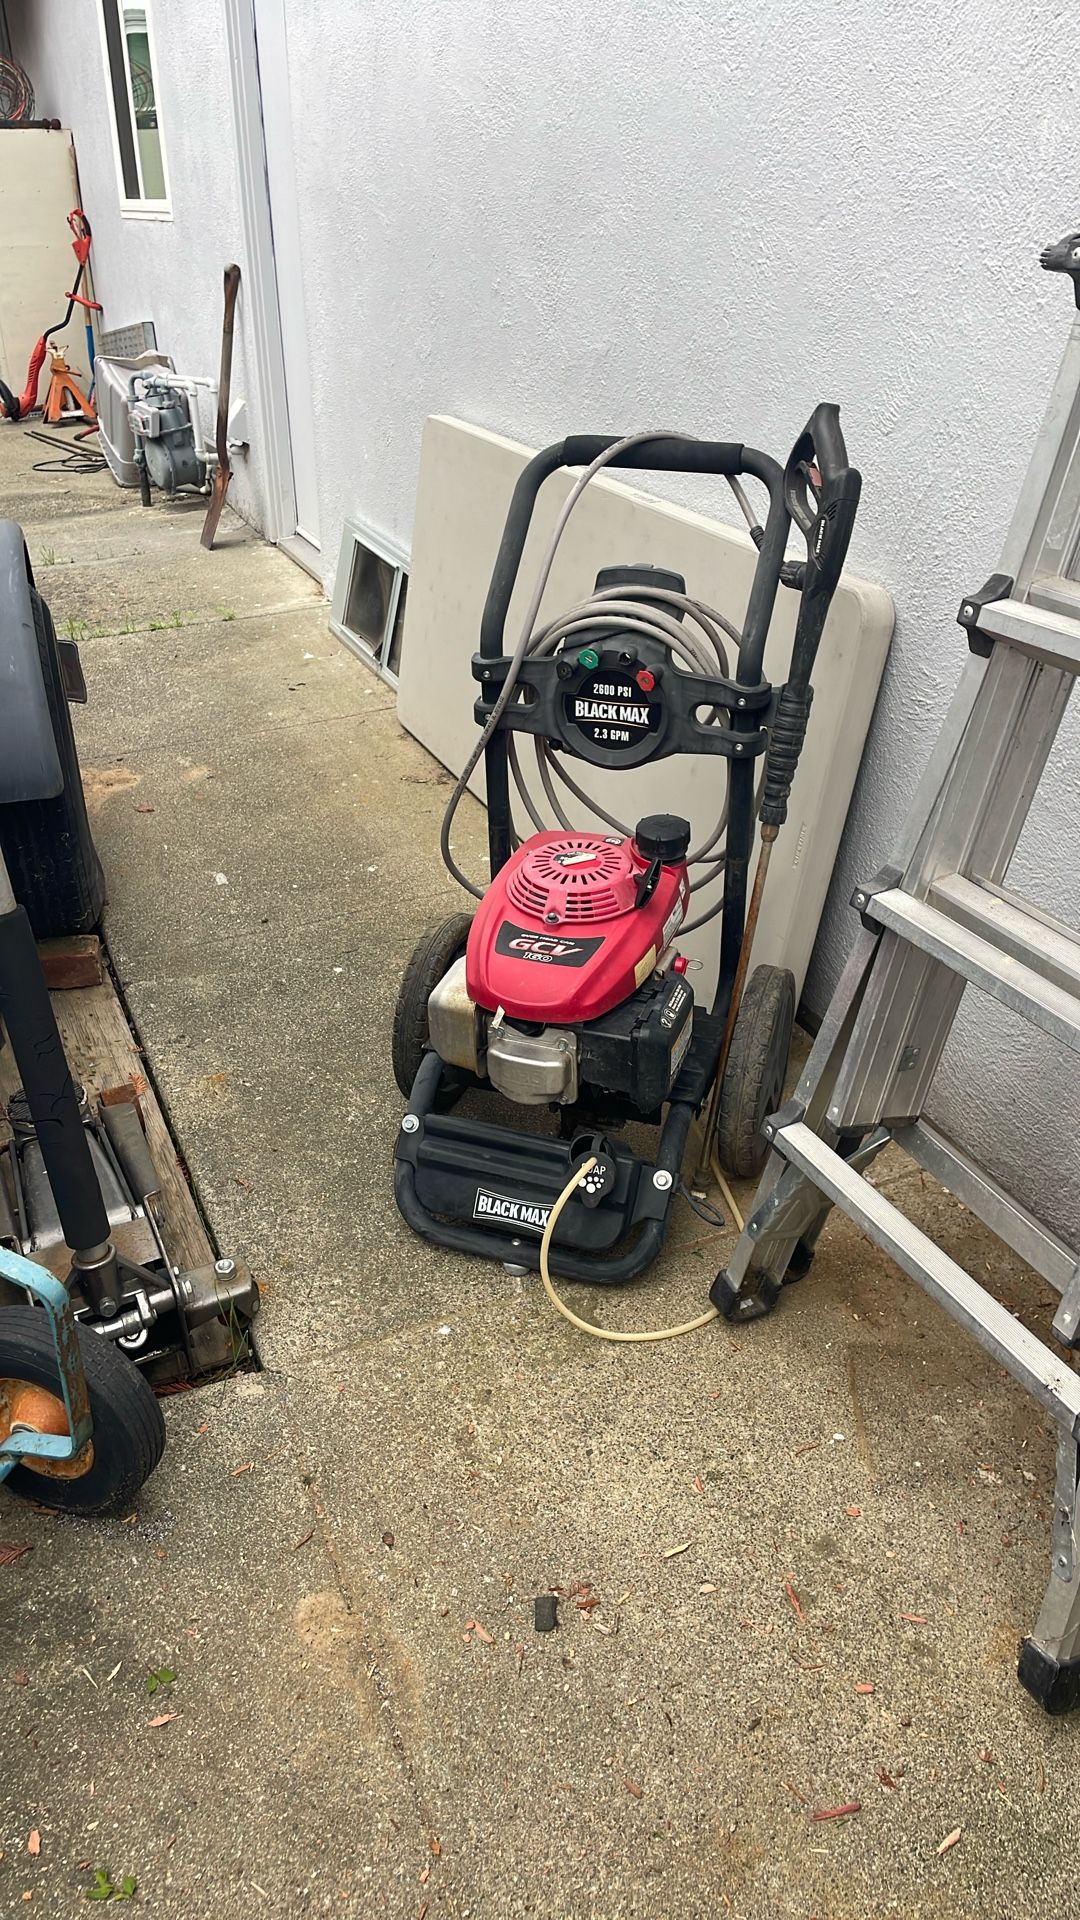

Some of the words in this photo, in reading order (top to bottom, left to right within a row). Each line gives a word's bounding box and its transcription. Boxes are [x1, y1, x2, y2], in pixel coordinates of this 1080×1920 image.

[593, 684, 615, 696] 2600
[617, 686, 632, 697] PSI
[575, 700, 618, 720] BLACK
[619, 706, 649, 724] MAX
[594, 728, 608, 739] 2.3
[610, 729, 629, 741] GPM
[508, 938, 584, 956] GCV
[523, 951, 553, 962] 160
[478, 1195, 519, 1219] BLACK
[520, 1206, 550, 1227] MAX
